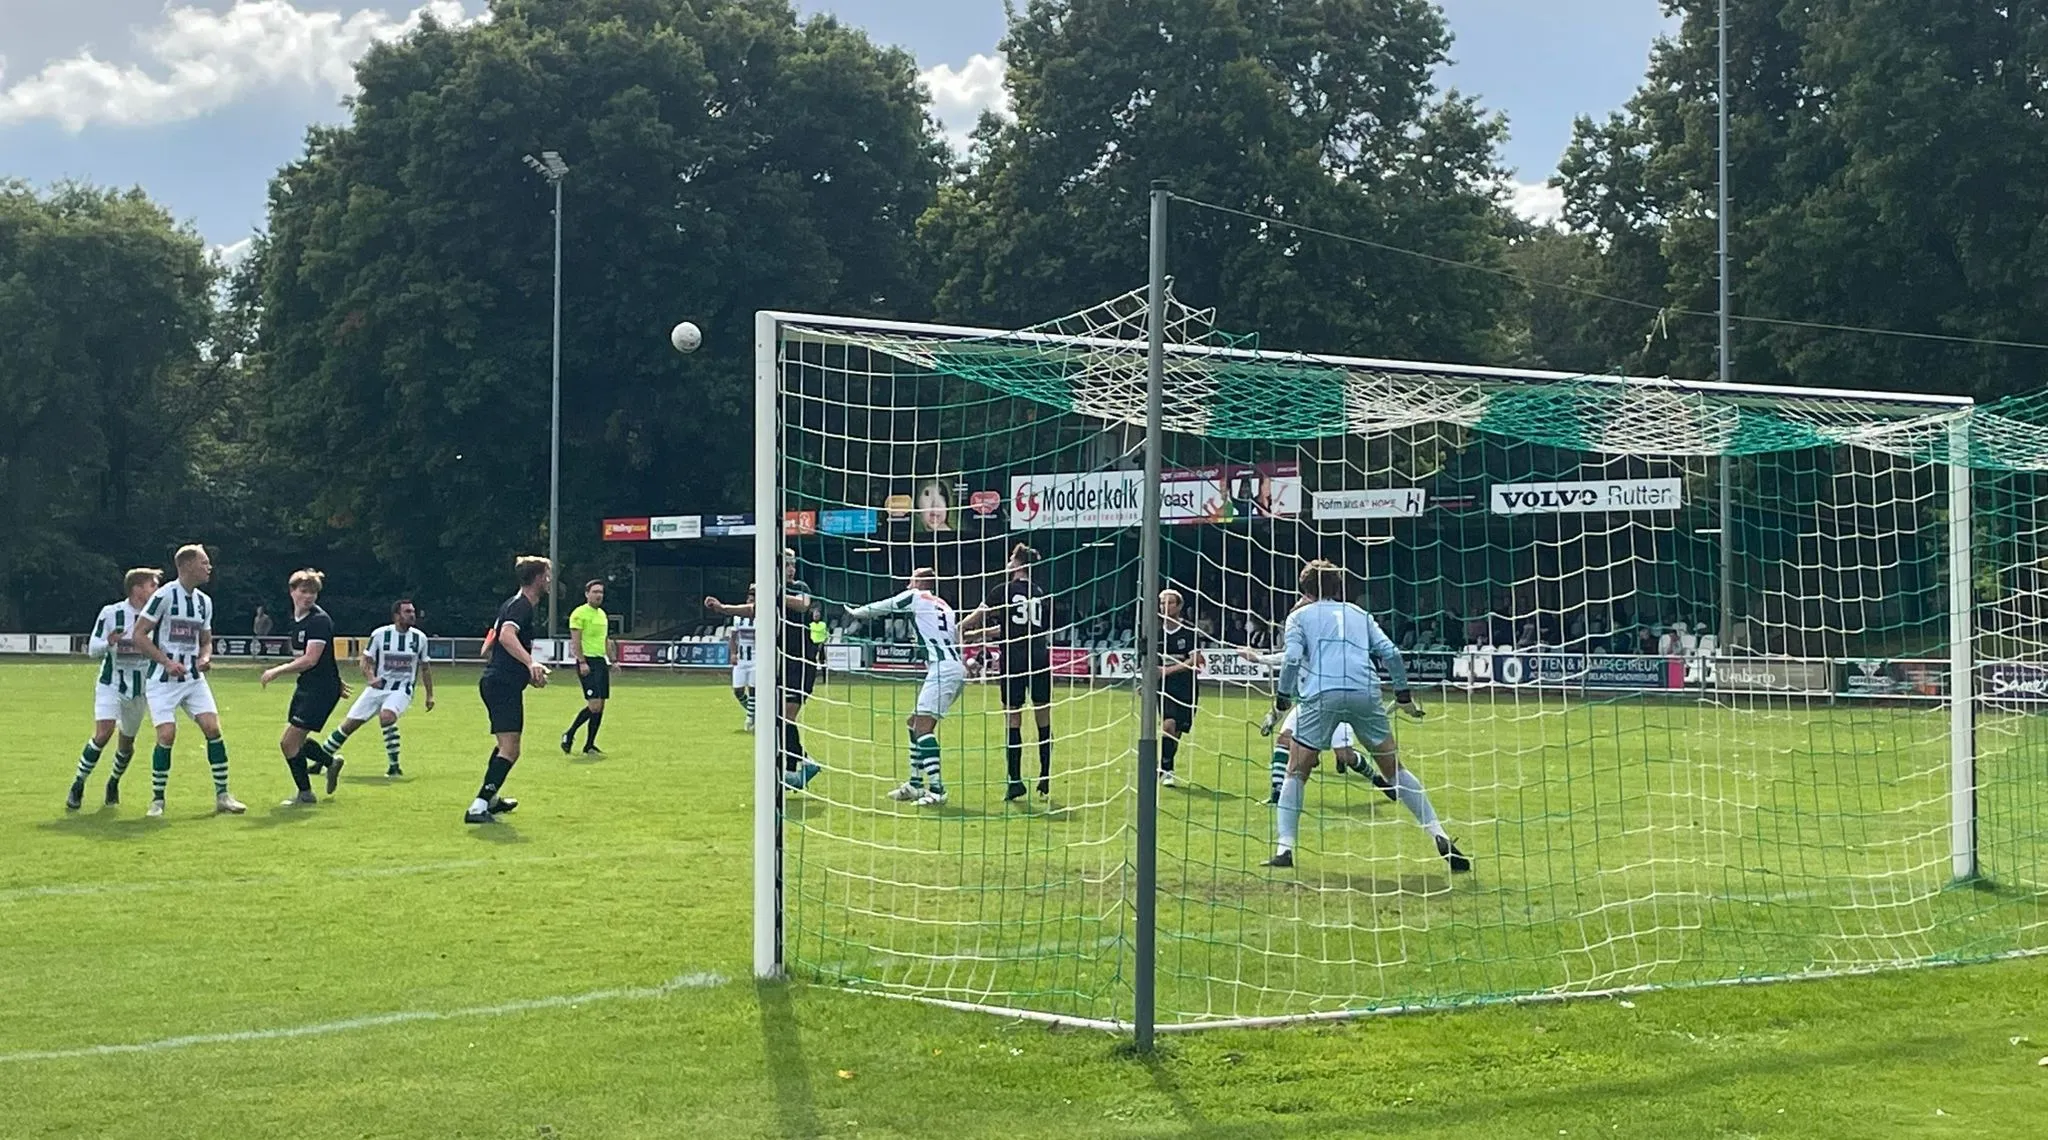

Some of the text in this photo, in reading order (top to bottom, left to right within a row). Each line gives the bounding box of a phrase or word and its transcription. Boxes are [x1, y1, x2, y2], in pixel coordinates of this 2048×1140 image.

[1500, 489, 1598, 508] VOLVO
[1608, 485, 1671, 505] Rutten
[935, 605, 948, 632] 3
[1011, 594, 1042, 627] 30
[1333, 610, 1344, 638] 1
[1208, 653, 1238, 665] SPORT
[1529, 657, 1563, 670] OTTEN
[1567, 658, 1575, 670] &
[1211, 664, 1258, 676] SNELDERS
[1719, 668, 1776, 684] Umberto
